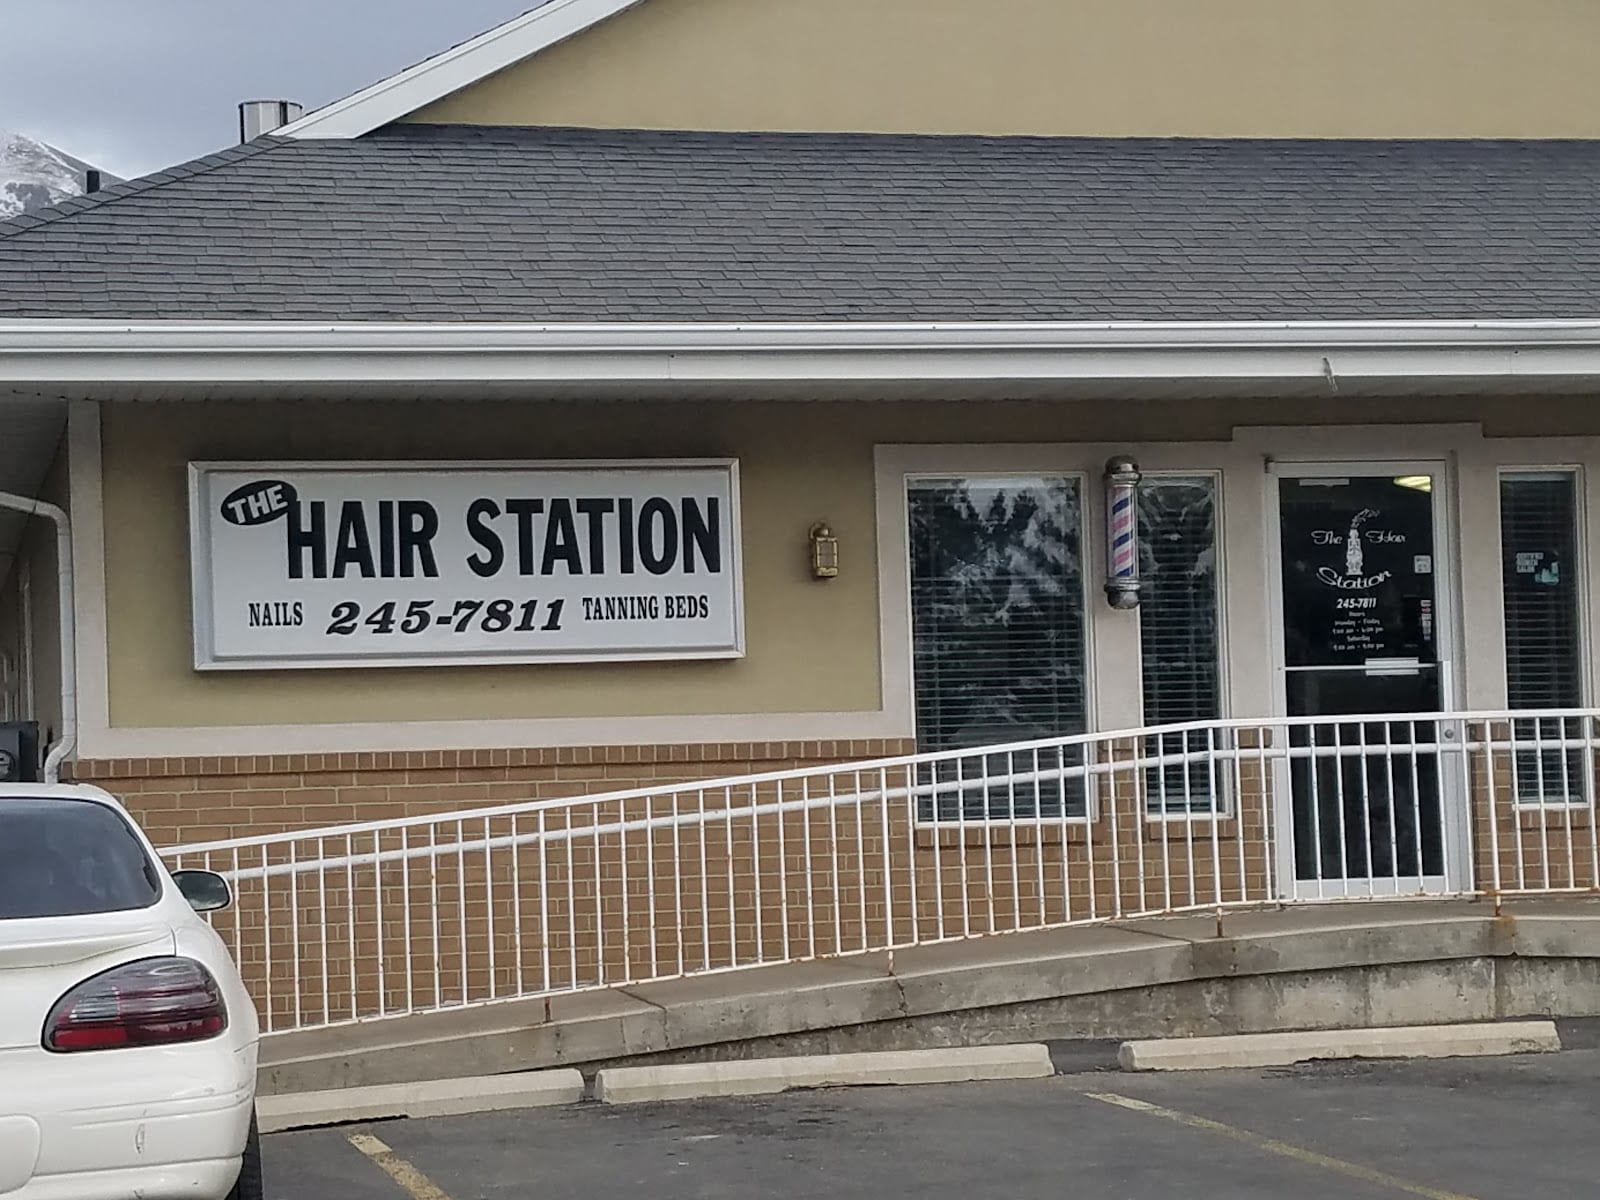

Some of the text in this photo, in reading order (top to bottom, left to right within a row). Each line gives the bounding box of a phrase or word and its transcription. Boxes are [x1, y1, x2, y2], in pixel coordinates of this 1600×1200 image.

[228, 485, 721, 579] THE HAIR STATION
[1310, 529, 1344, 545] The
[1316, 566, 1392, 589] Station
[248, 602, 303, 627] NAILS
[582, 595, 708, 620] TANNING BEDS
[1336, 597, 1377, 609] 245-7811
[325, 599, 565, 635] 245-7811
